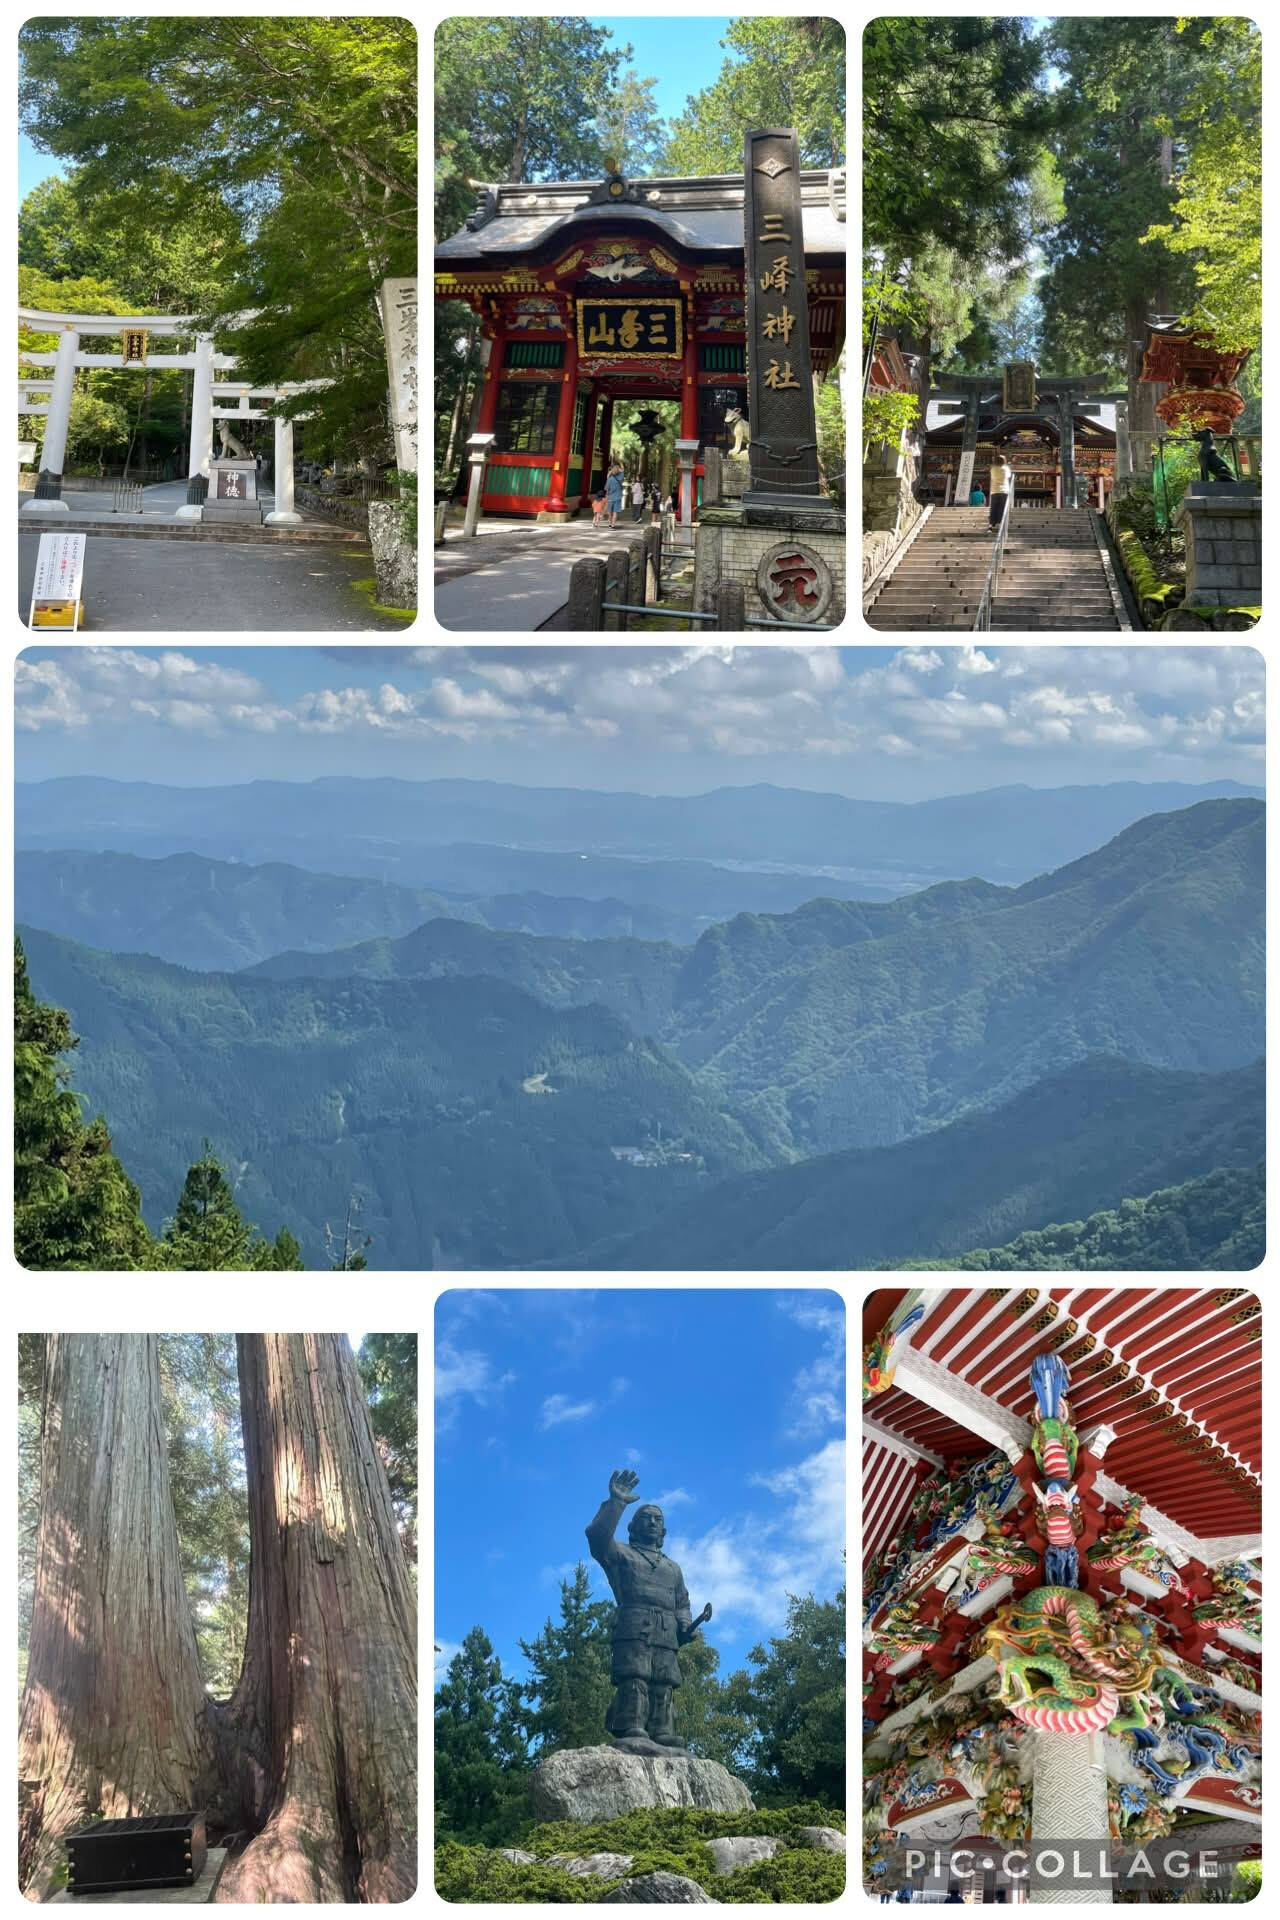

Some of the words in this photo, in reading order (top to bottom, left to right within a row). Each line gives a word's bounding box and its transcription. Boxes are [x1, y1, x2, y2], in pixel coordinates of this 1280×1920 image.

[759, 213, 801, 390] 三峰神社
[769, 554, 819, 607] 元
